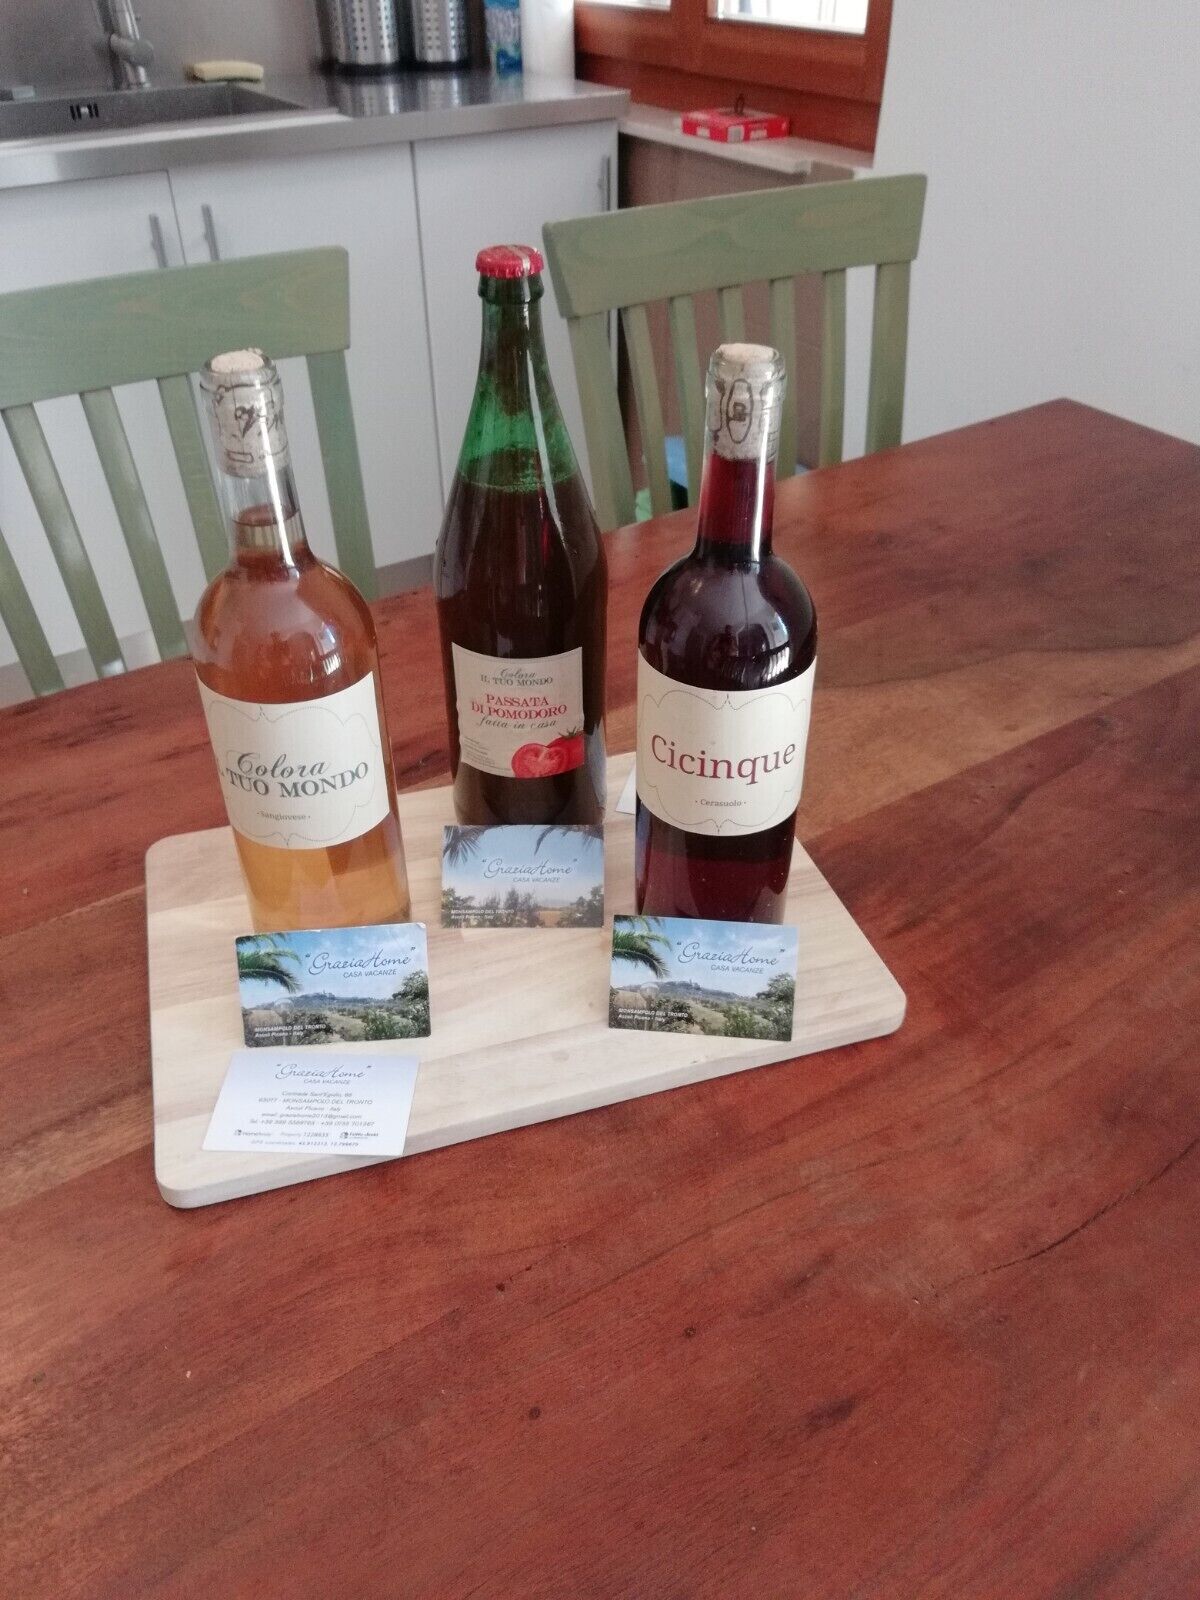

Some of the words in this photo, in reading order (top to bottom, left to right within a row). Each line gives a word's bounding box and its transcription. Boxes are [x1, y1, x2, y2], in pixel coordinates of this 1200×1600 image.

[492, 676, 514, 686] TUO
[516, 677, 553, 687] MONDO
[486, 693, 549, 707] PASSATA
[471, 701, 485, 714] DI
[488, 704, 568, 720] POMODORO
[530, 719, 558, 729] casa
[236, 752, 329, 779] Colora
[651, 734, 797, 786] Cicinque
[226, 767, 270, 796] TUO
[276, 761, 369, 798] MONDO
[700, 799, 742, 807] Cerasuolo
[343, 970, 363, 978] CASA
[364, 968, 397, 977] VACANZE
[711, 964, 731, 972] CASA
[732, 966, 765, 974] VACANZE
